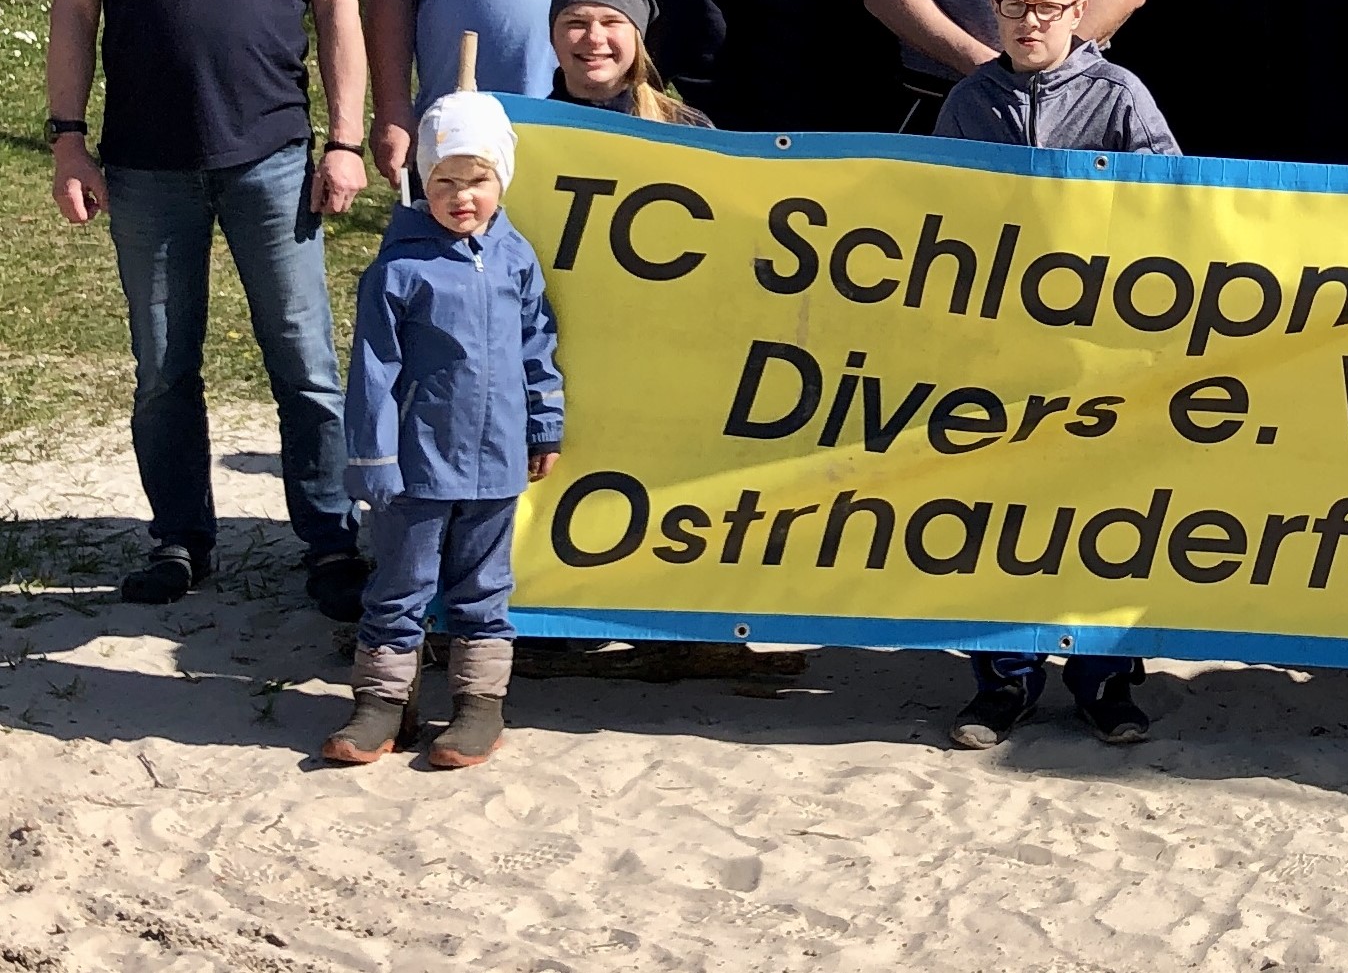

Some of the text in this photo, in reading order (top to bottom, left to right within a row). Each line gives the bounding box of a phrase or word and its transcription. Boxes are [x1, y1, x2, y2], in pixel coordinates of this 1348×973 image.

[552, 175, 715, 282] TC
[722, 339, 1126, 455] Divers
[1168, 376, 1279, 445] e.
